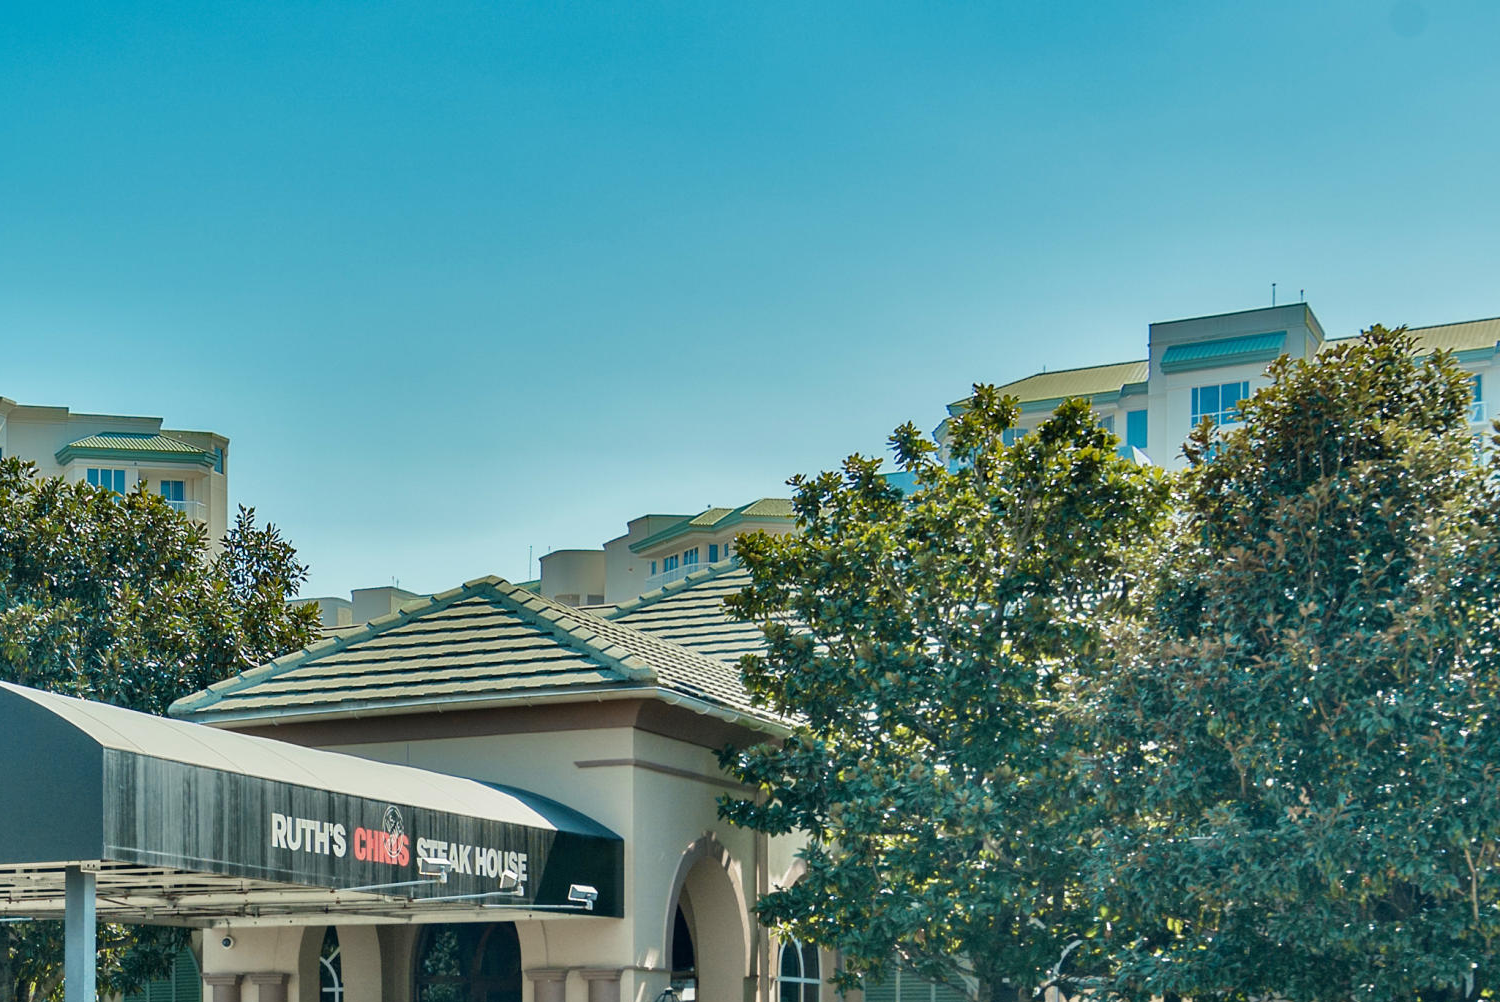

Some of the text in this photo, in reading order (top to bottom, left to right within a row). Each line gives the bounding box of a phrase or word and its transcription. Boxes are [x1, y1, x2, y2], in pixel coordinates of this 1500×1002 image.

[271, 812, 347, 858] RUTH'S
[354, 827, 410, 867] CHRIS
[475, 846, 528, 882] HOUSE
